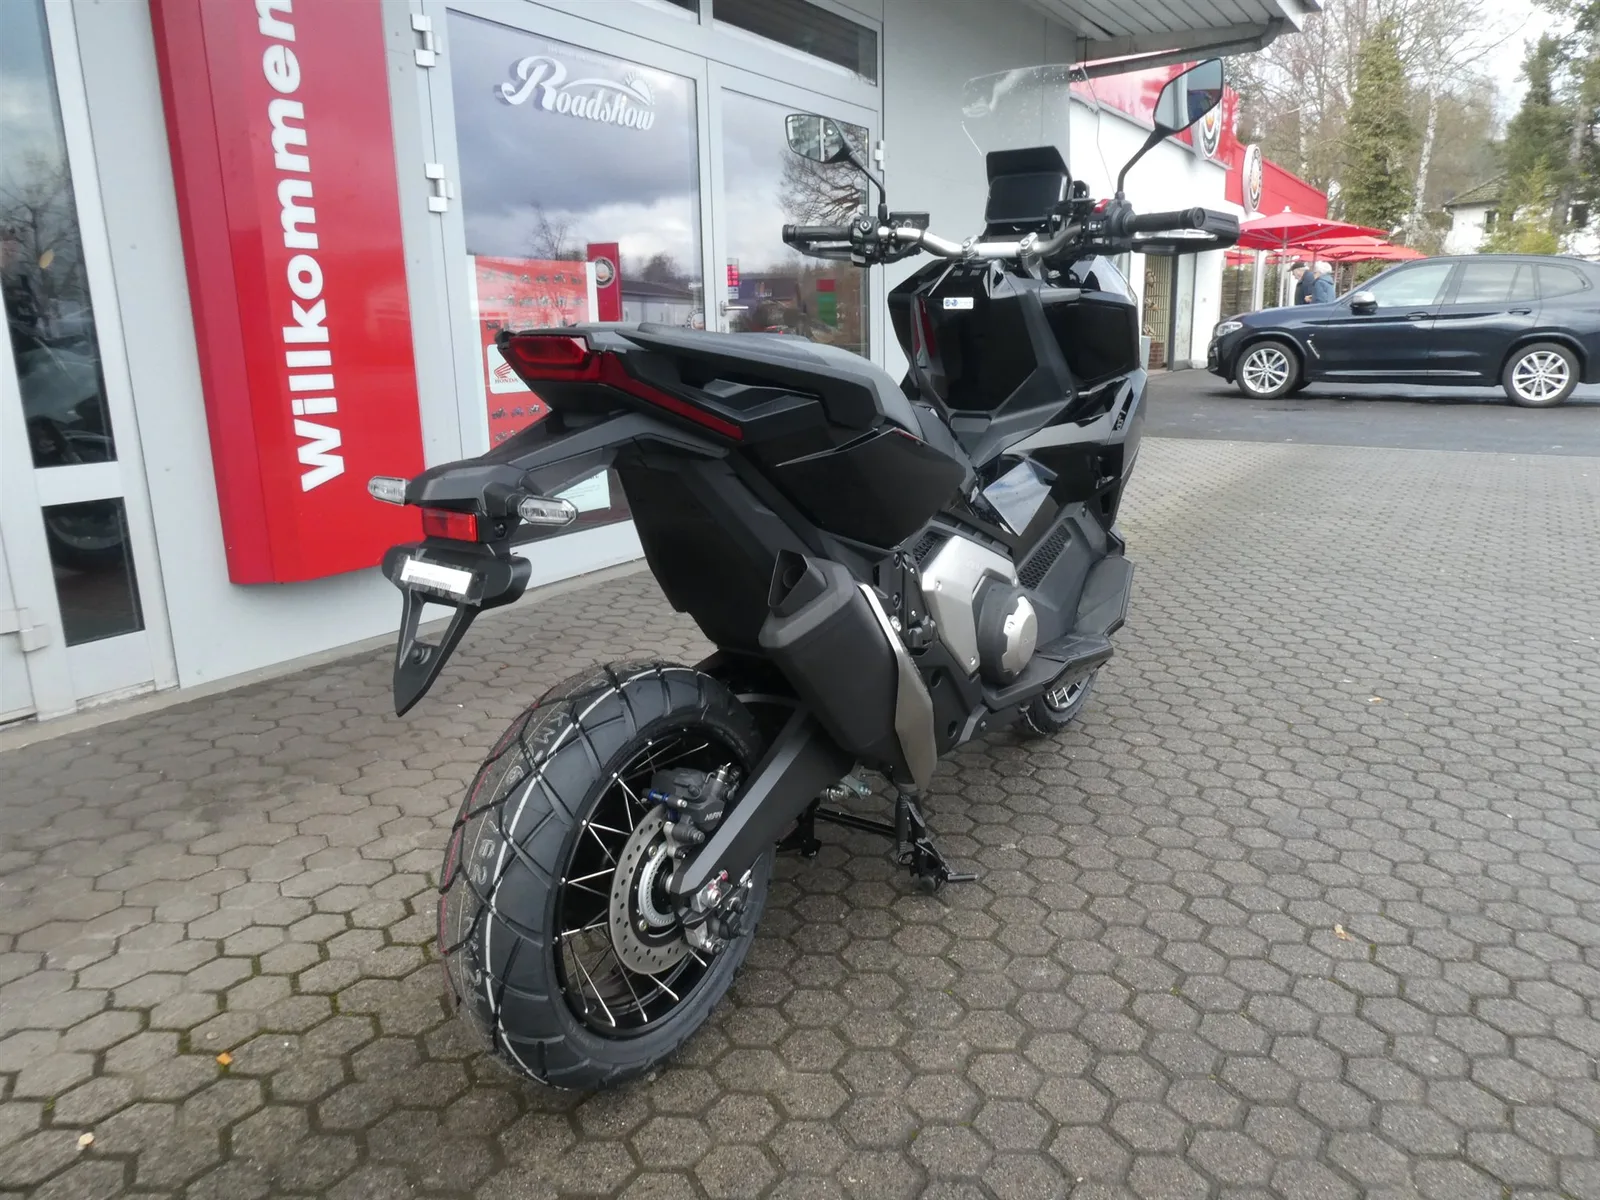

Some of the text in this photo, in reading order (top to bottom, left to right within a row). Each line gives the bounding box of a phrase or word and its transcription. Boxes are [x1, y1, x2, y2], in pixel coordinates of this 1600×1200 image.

[501, 55, 655, 130] Roadshow
[254, 0, 345, 493] Willkommen
[494, 377, 519, 385] HONDA
